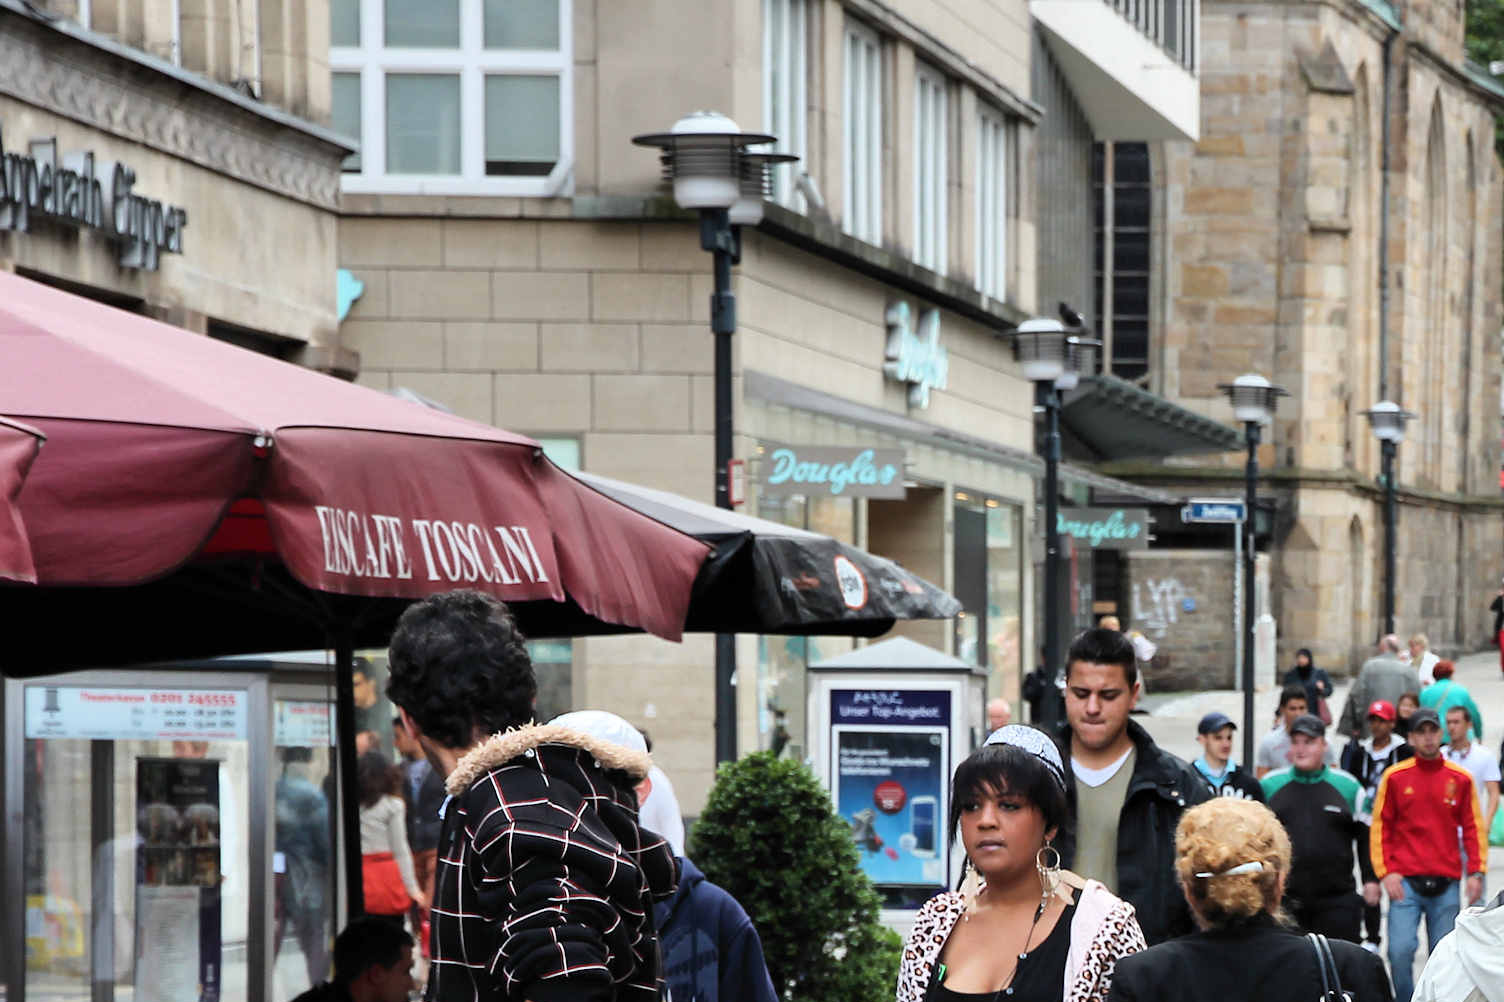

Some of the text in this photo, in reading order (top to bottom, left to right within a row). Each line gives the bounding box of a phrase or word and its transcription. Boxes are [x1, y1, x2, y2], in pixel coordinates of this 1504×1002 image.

[767, 448, 898, 495] Douglas
[315, 505, 550, 585] EISCAFE TOSCANI
